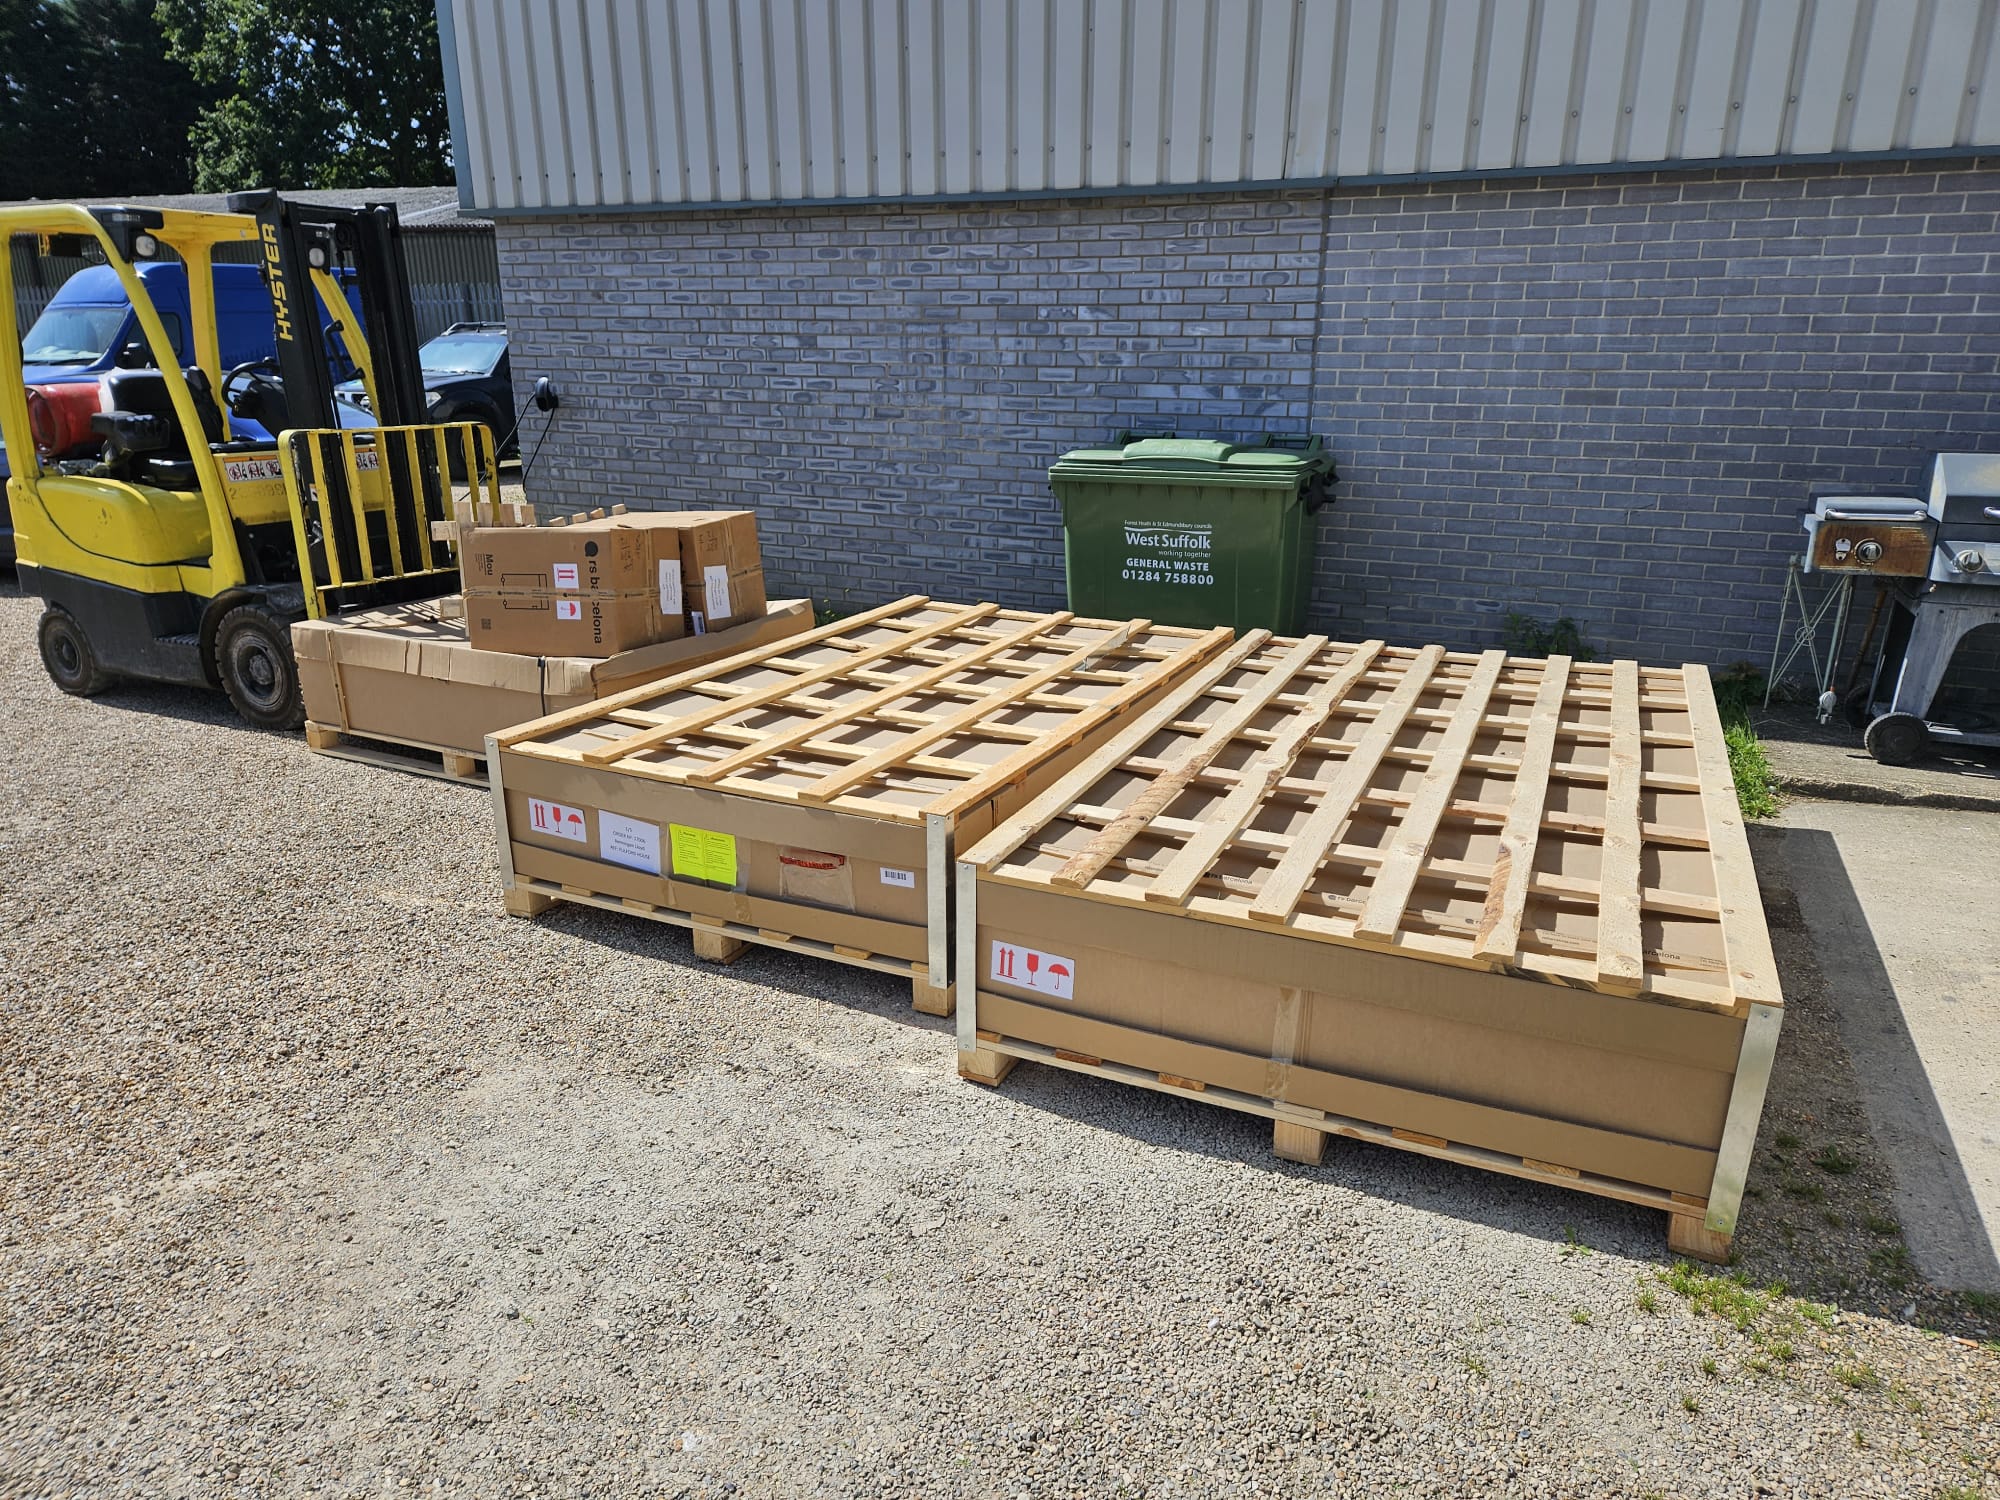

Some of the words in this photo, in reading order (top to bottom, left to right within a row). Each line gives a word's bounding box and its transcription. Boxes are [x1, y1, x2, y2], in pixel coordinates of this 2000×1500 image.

[262, 223, 293, 341] HYSTER
[1125, 532, 1160, 546] West
[1161, 534, 1211, 549] Suffolk
[1158, 550, 1182, 558] working
[1184, 551, 1211, 559] together
[485, 554, 493, 576] Mou
[589, 560, 597, 573] rs
[1126, 558, 1171, 569] GENERAL
[1174, 561, 1209, 571] WASTE
[1122, 569, 1160, 582] 01284
[1164, 572, 1214, 585] 758800
[590, 577, 603, 644] bacelona
